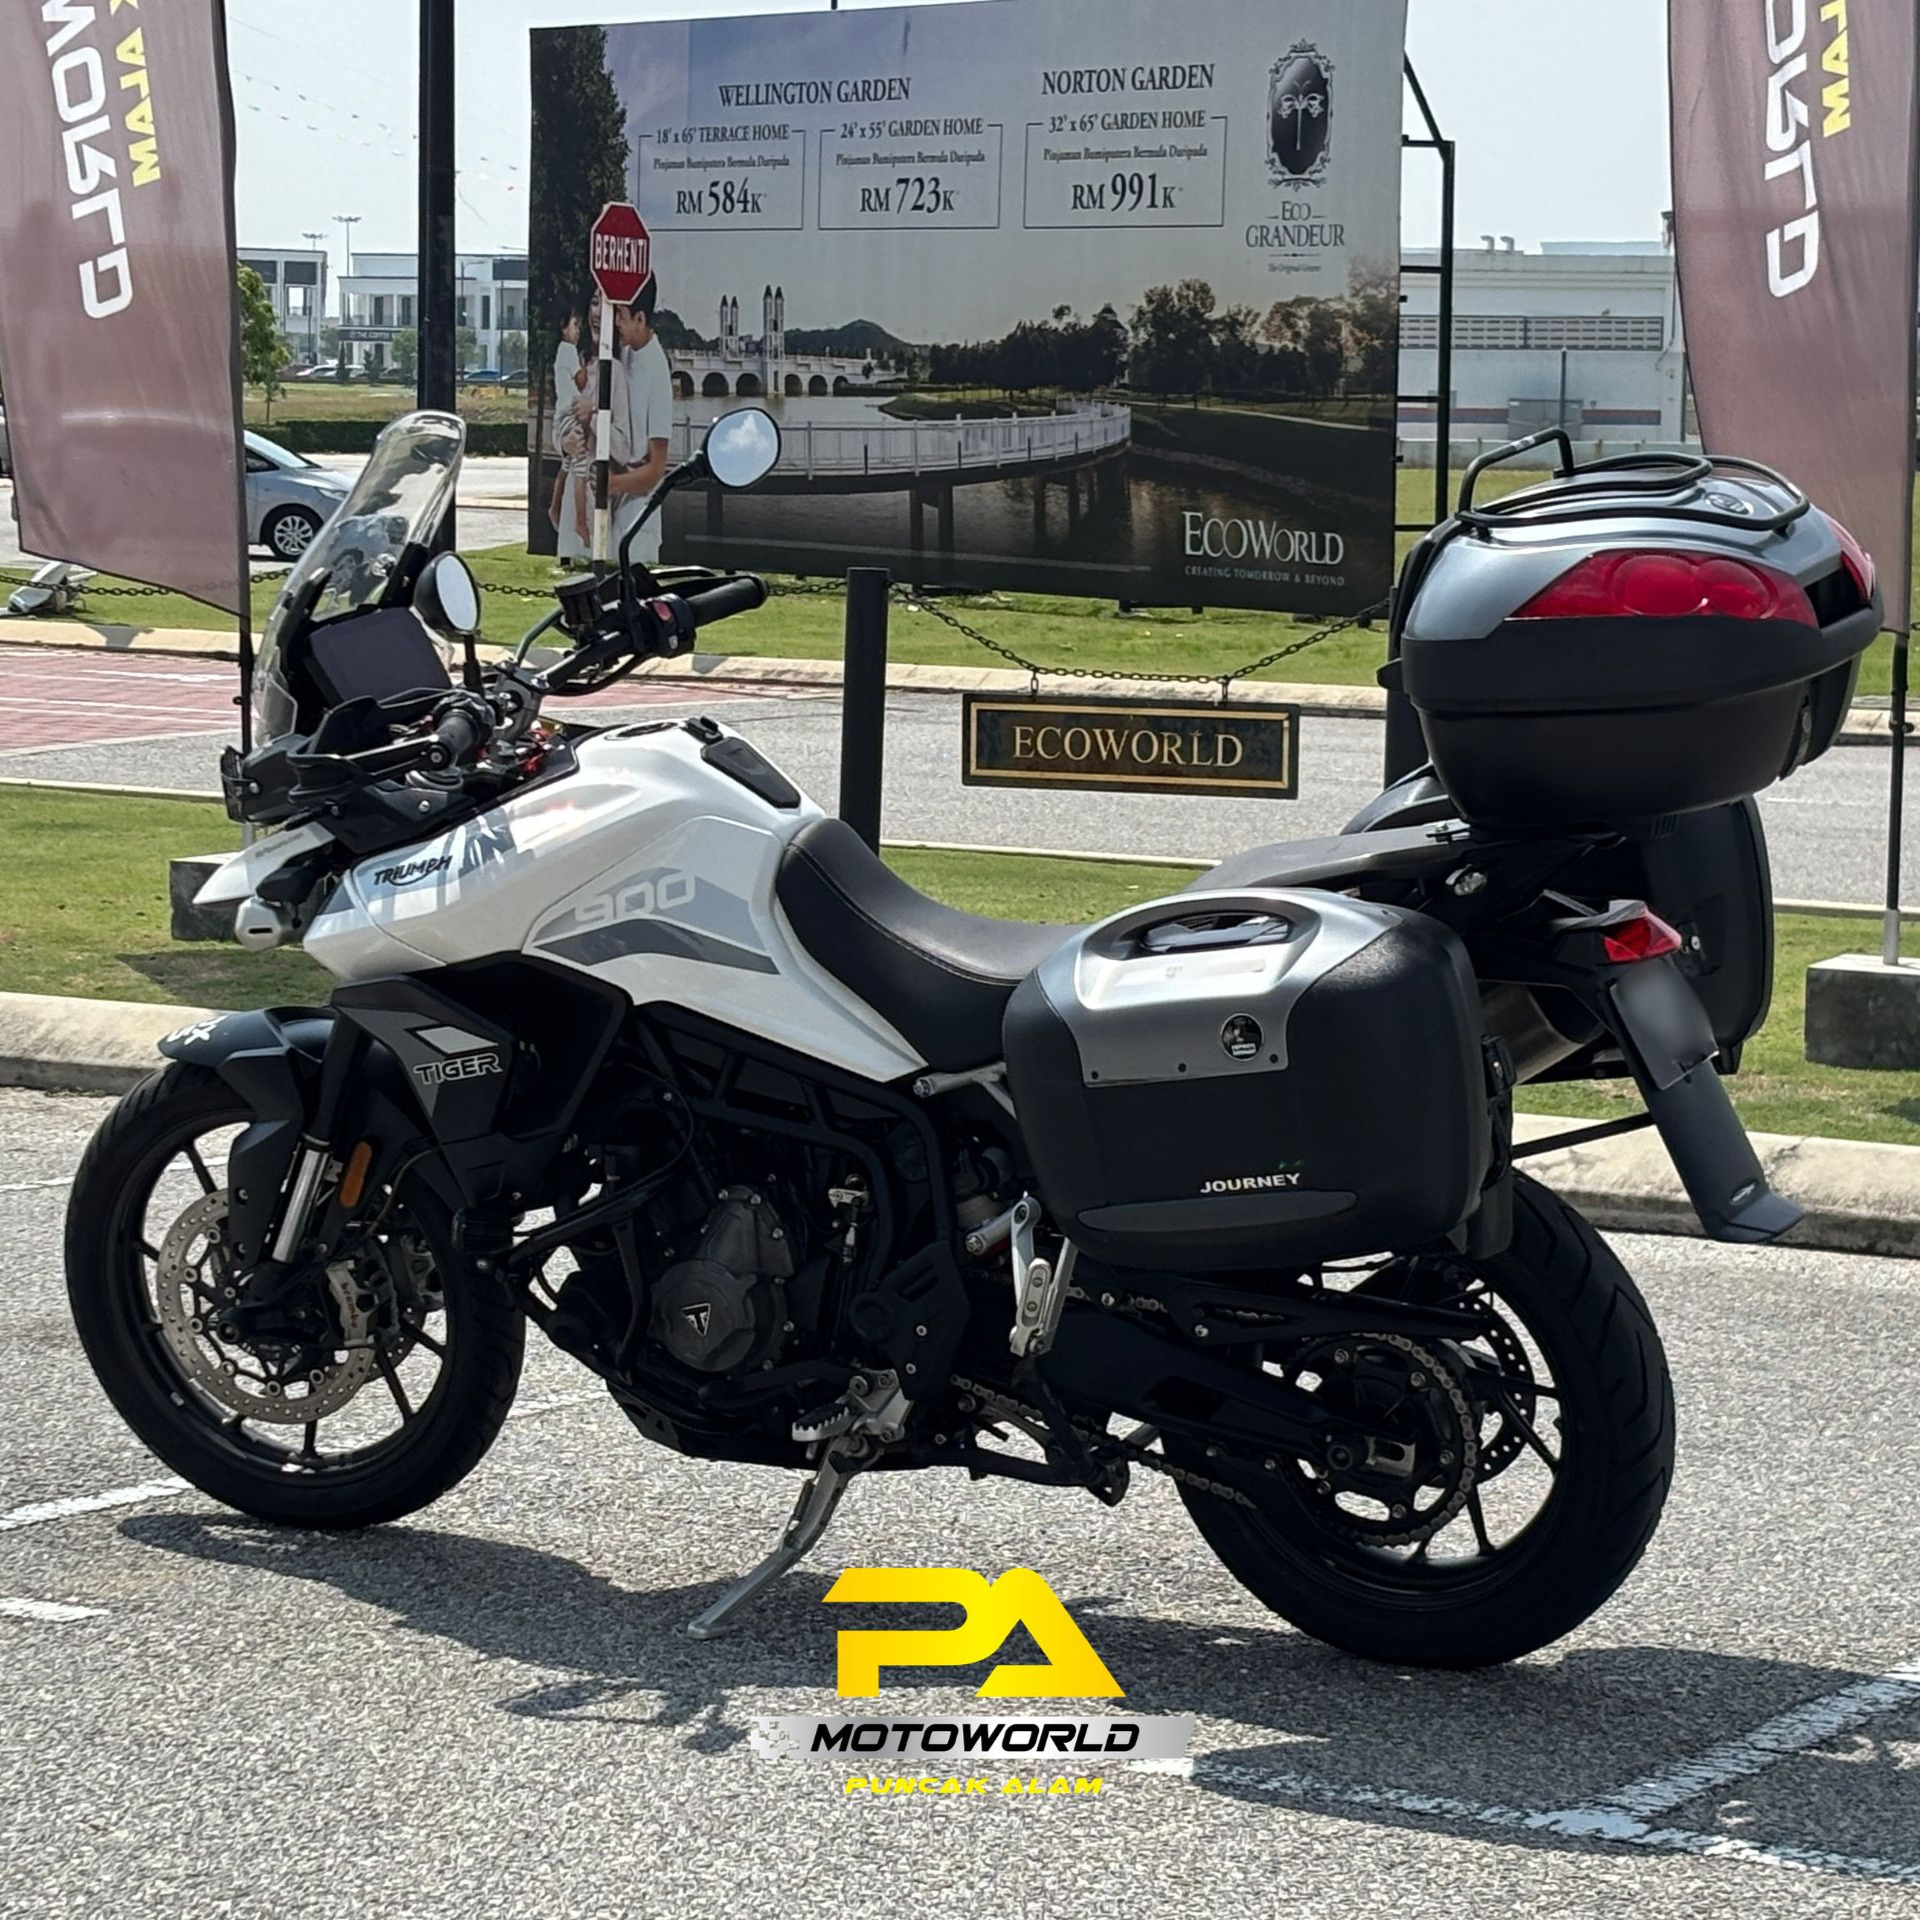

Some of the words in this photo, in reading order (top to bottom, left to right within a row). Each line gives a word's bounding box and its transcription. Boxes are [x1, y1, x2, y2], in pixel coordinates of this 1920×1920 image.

[718, 81, 833, 106] WELLINGTON
[837, 77, 911, 102] GARDEN
[1042, 68, 1126, 95] NORTON
[1131, 64, 1215, 91] GARDEN
[888, 119, 940, 137] GARDEN
[943, 117, 983, 135] HOME
[1101, 112, 1158, 131] GARDEN
[1161, 110, 1206, 128] HOME
[700, 125, 749, 143] TERRACE
[752, 124, 789, 141] HOME
[676, 189, 703, 214] RM
[860, 187, 891, 212] RM
[1071, 184, 1105, 210] RM
[1245, 224, 1345, 248] GRANDEUR
[594, 233, 647, 275] BERHENTI
[1184, 565, 1231, 578] CREATING
[1234, 568, 1290, 583] TOMORROW
[1304, 573, 1345, 587] BEYOND
[1012, 726, 1243, 768] ECOWORLD
[373, 855, 453, 887] TRIUMPH
[574, 873, 695, 921] 900
[413, 1052, 503, 1085] TIGER
[1200, 1173, 1300, 1193] JOURNEY
